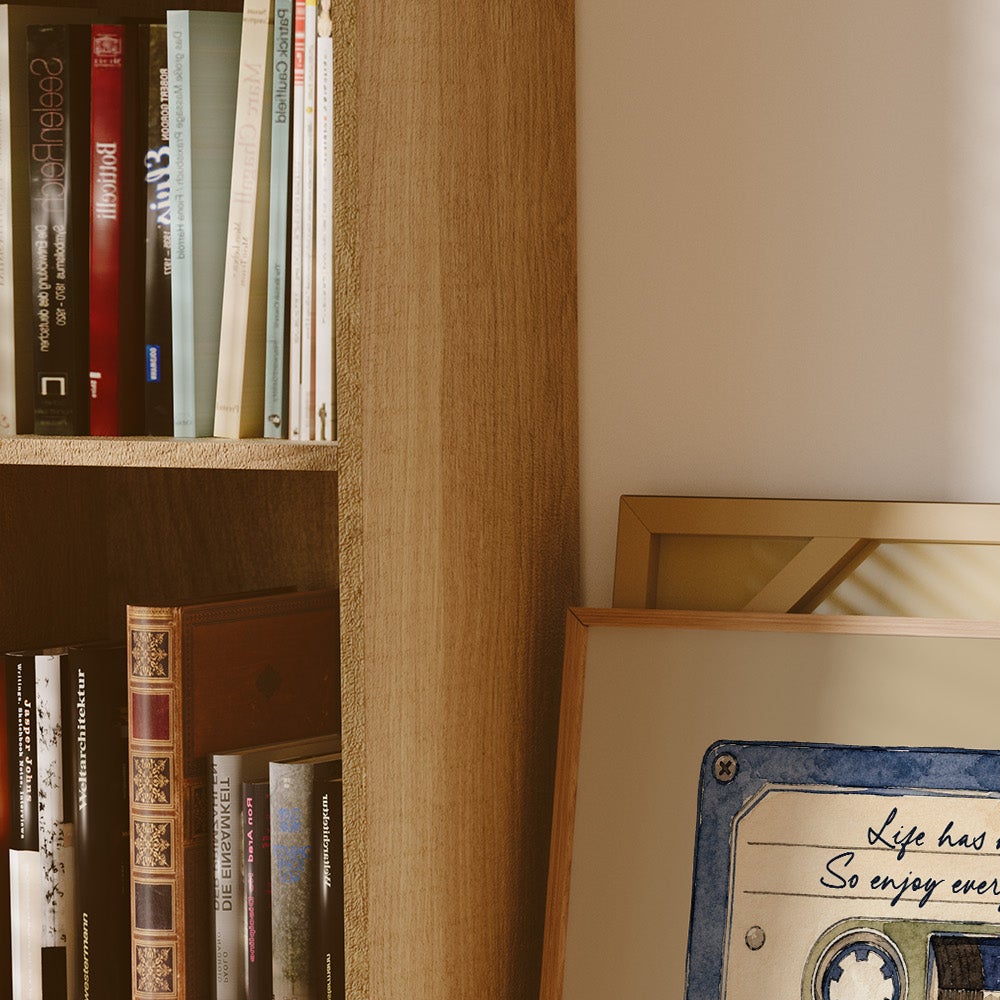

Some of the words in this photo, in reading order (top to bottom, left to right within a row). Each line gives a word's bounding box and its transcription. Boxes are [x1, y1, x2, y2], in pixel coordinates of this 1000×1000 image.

[23, 700, 32, 754] Jasper
[77, 668, 87, 812] Weltarchitektur
[23, 756, 32, 803] Johns
[866, 807, 925, 860] Life
[937, 820, 986, 851] has
[819, 852, 859, 890] So
[869, 871, 945, 907] enjoy
